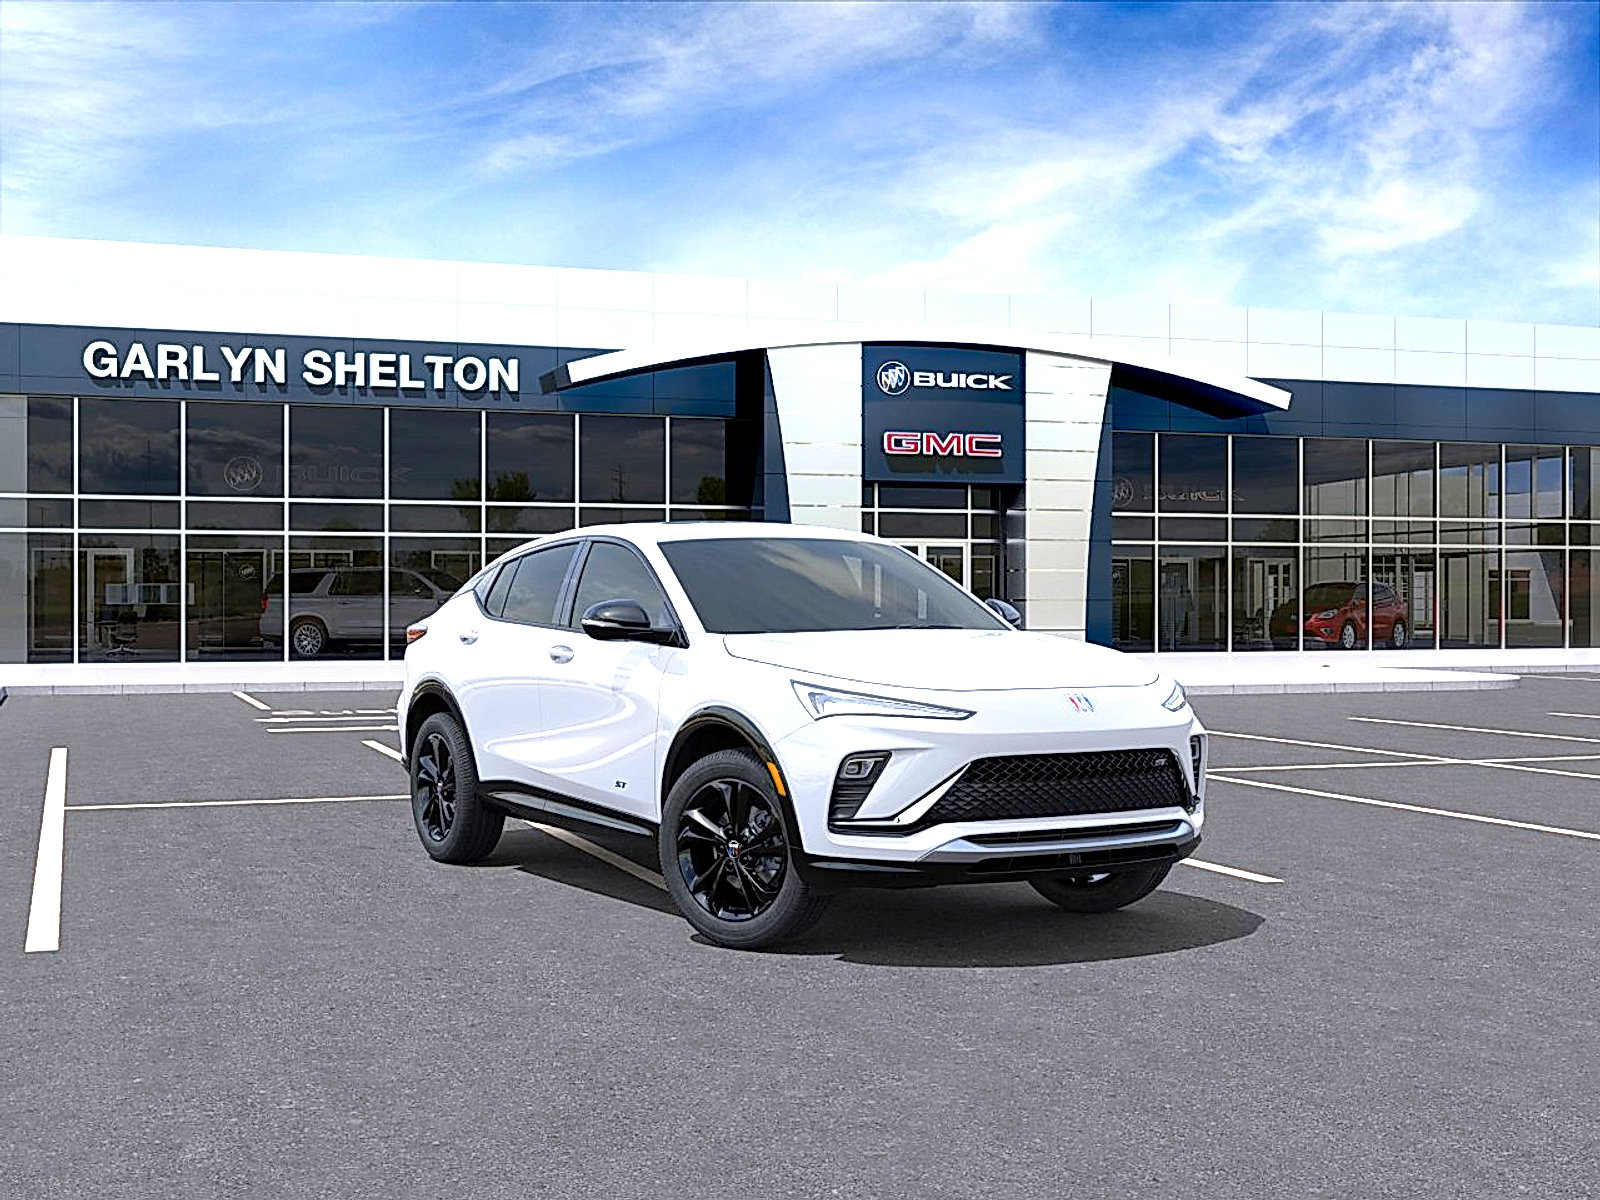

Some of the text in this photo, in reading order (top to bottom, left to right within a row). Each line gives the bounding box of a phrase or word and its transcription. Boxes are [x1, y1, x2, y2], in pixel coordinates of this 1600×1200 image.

[82, 340, 520, 393] GARLYN SHELTON
[912, 370, 1014, 391] BUICK
[882, 430, 1003, 458] GMC
[614, 780, 628, 789] ST
